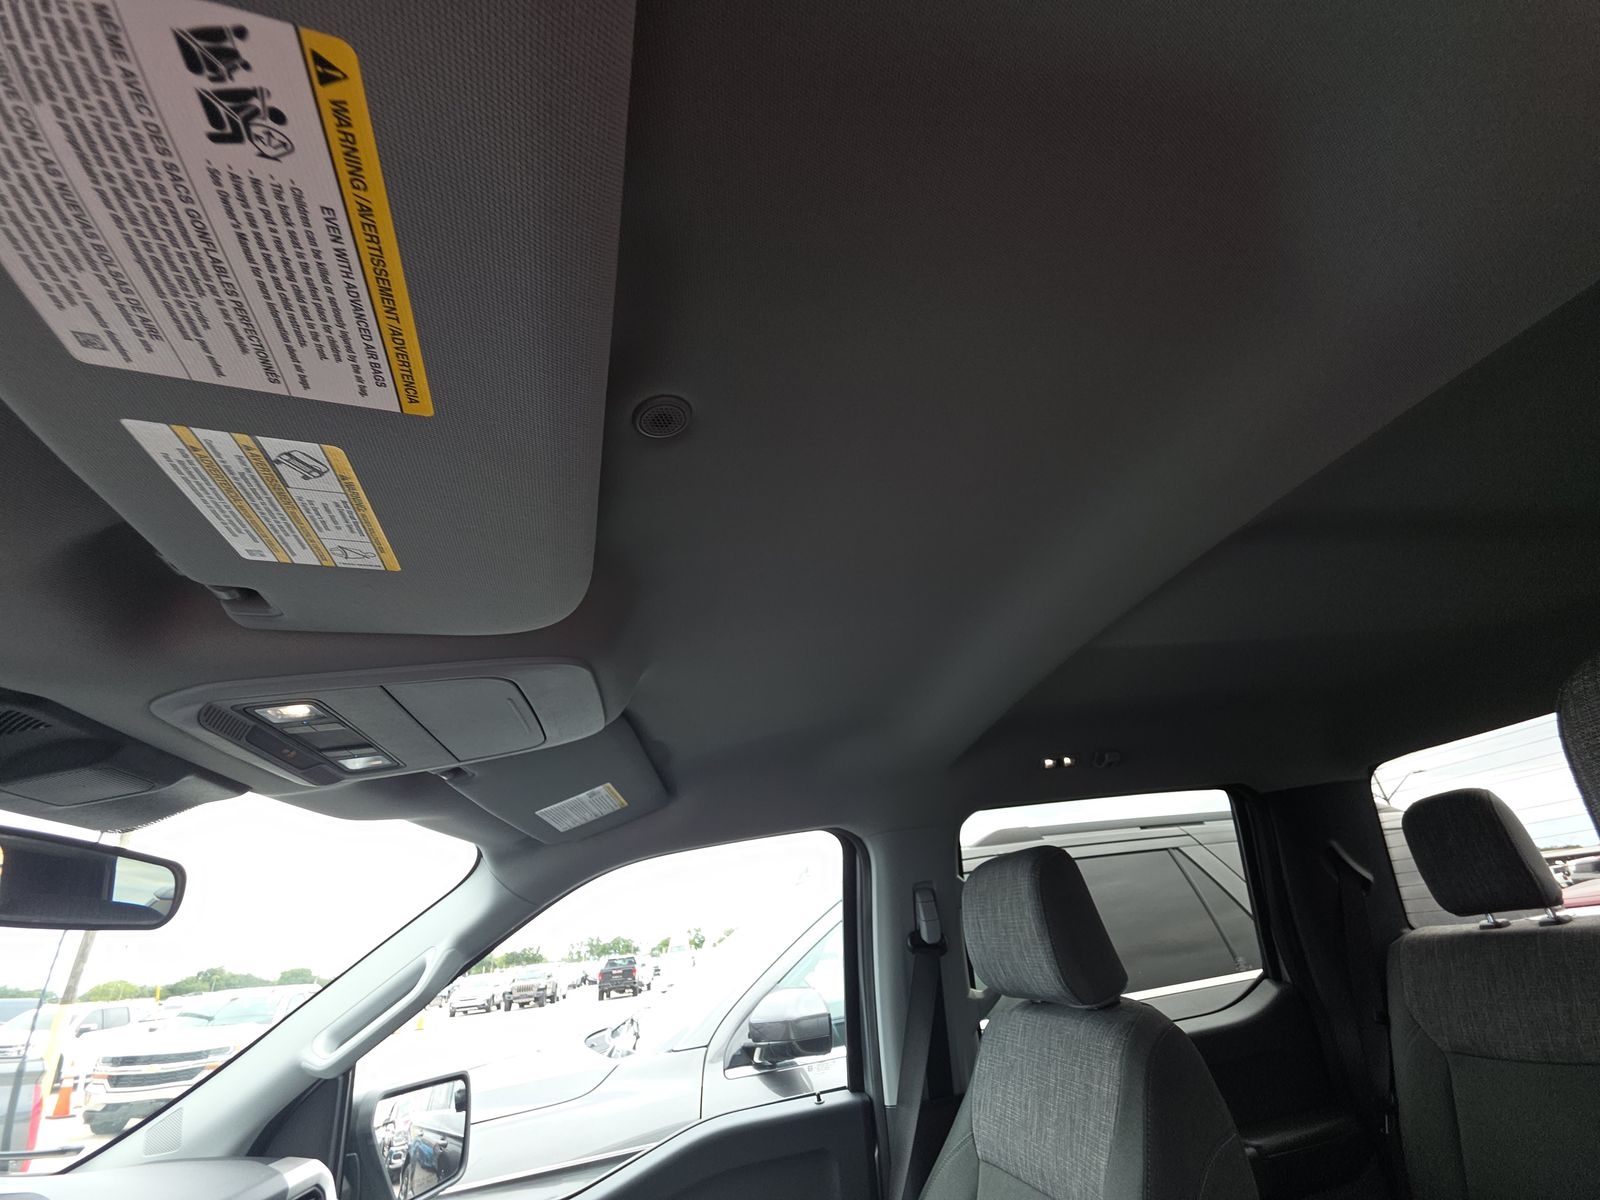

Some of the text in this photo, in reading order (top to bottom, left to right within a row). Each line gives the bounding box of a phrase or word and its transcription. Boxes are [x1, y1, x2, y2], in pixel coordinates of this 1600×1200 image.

[7, 102, 46, 144] CON
[29, 143, 66, 180] LAS
[205, 165, 227, 189] See
[87, 0, 135, 65] MÊME
[115, 64, 156, 119] AVEC
[140, 119, 175, 159] DES
[159, 159, 197, 206] SACS
[182, 206, 240, 298] GONFLABLES
[227, 298, 284, 385] PERFECTIONNÉS
[223, 169, 255, 211] Always
[247, 175, 272, 207] Never
[49, 179, 103, 242] NUEVAS
[214, 188, 245, 231] Owner's
[243, 210, 260, 230] use
[257, 206, 279, 227] put
[251, 229, 272, 252] seat
[267, 226, 280, 235] a
[233, 230, 259, 265] Manual
[326, 95, 421, 405] WARNING /AVERTISSEMENT /ADVERTENCIA
[87, 241, 137, 296] BOLSAS
[248, 264, 265, 279] for
[260, 251, 281, 275] belts
[268, 180, 345, 365] The back seat is the safest place for children.
[254, 278, 272, 301] more
[269, 274, 288, 292] and
[288, 184, 371, 399] Children can be killed or seriously injured by the air bag.
[289, 282, 309, 304] child
[123, 295, 148, 314] DE
[276, 291, 296, 312] child
[318, 204, 387, 388] EVEN WITH ADVANCED AIR BAGS
[297, 303, 315, 322] seat
[135, 314, 166, 343] AIRE
[304, 321, 318, 330] in
[308, 329, 323, 343] the
[282, 342, 301, 364] about
[313, 342, 330, 362] front.
[291, 363, 305, 373] air
[293, 372, 313, 392] bags.
